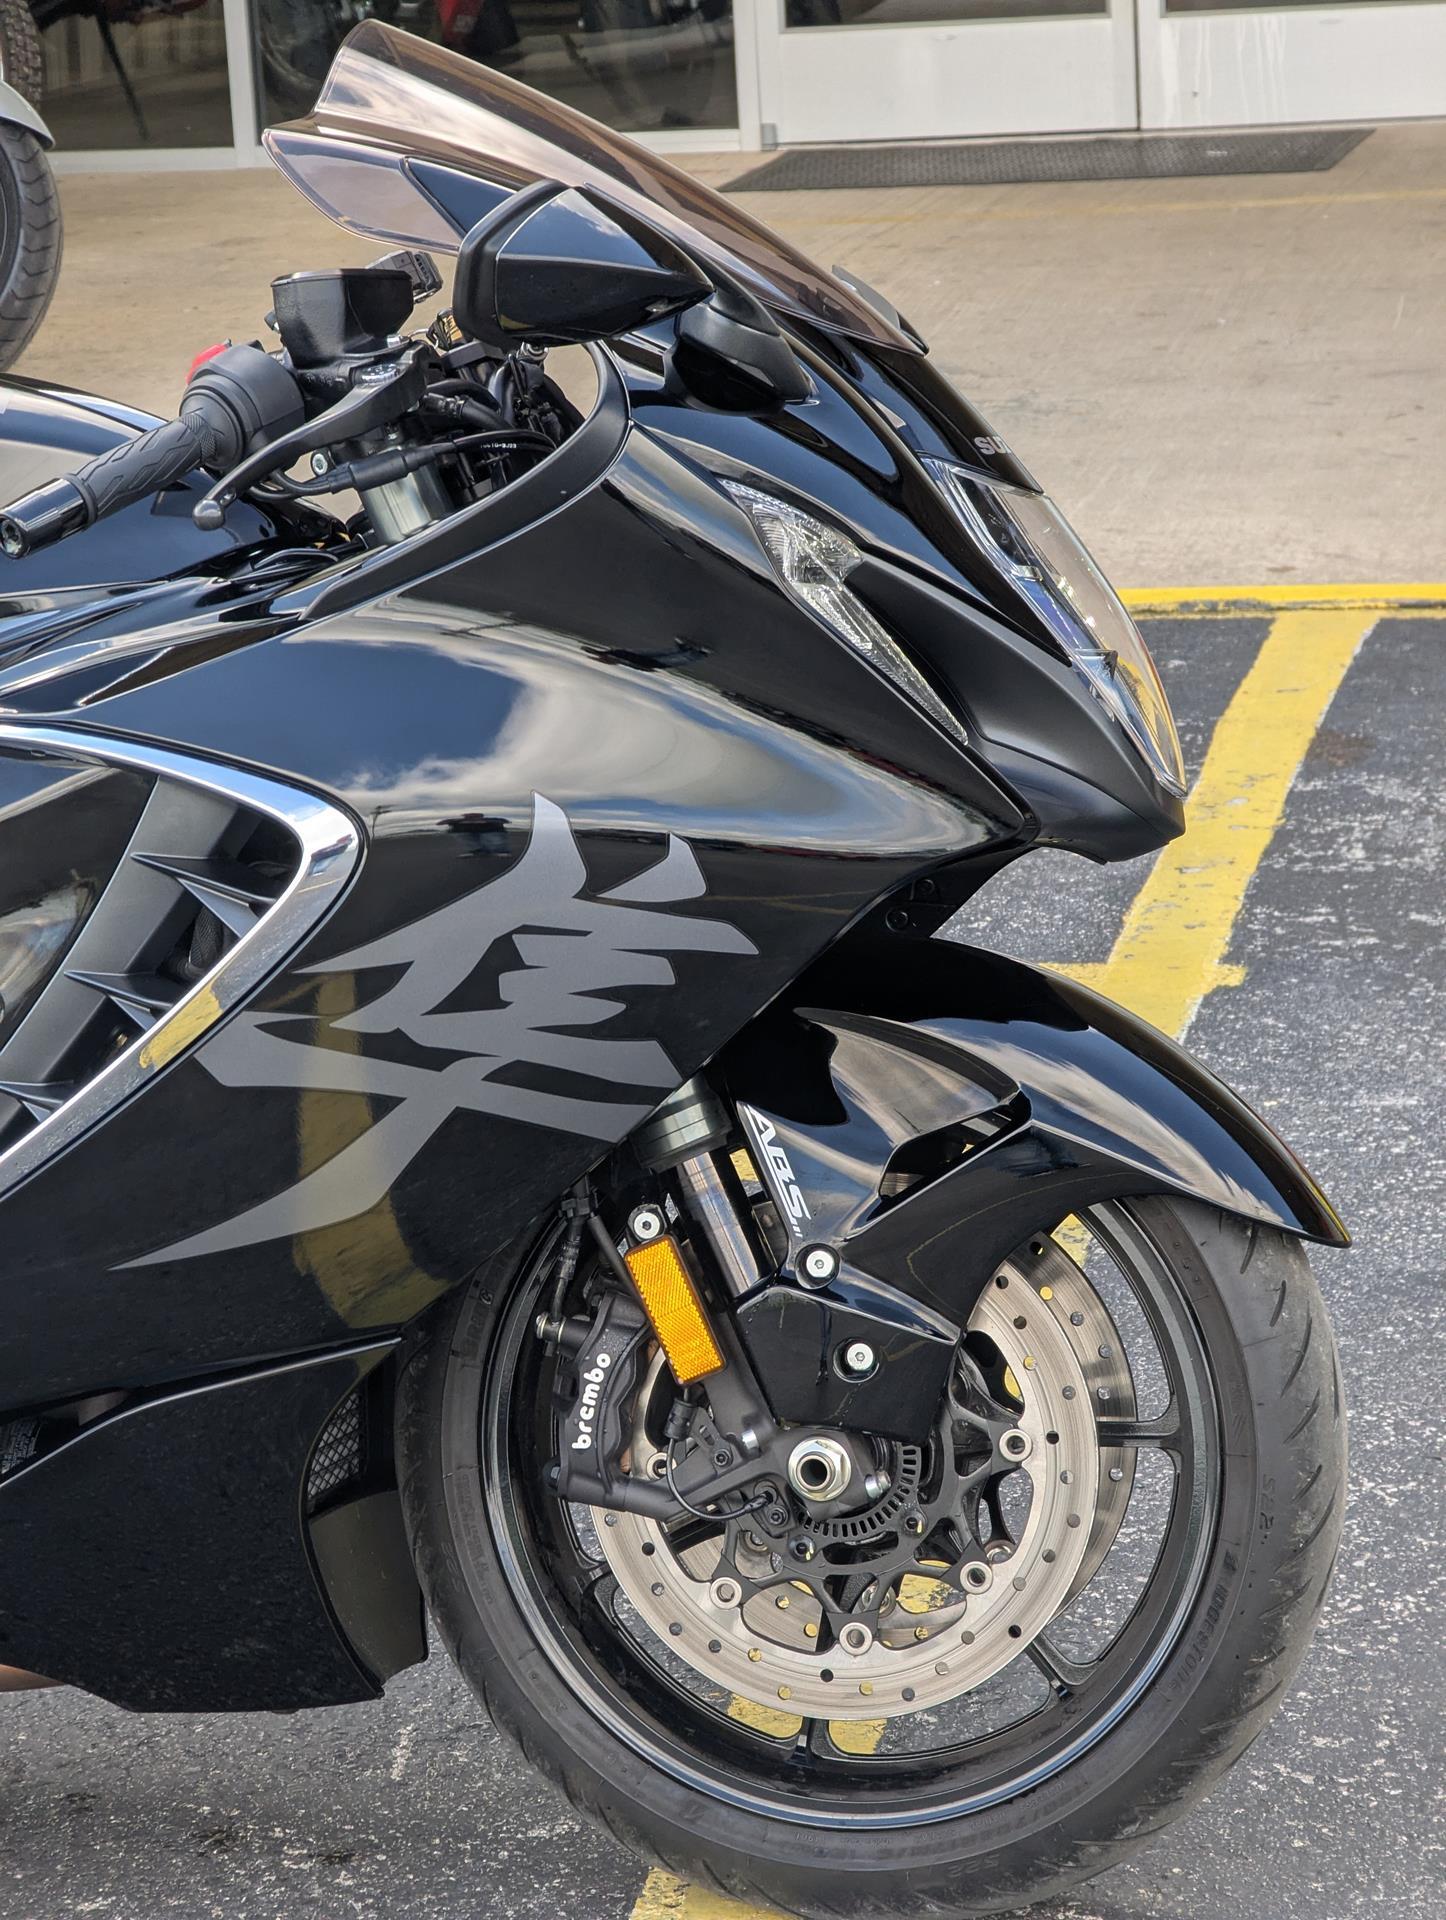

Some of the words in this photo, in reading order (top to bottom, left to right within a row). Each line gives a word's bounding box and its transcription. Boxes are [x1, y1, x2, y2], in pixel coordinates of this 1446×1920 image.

[974, 436, 1011, 455] SU
[746, 1103, 812, 1221] ABS
[571, 1353, 611, 1450] brembo
